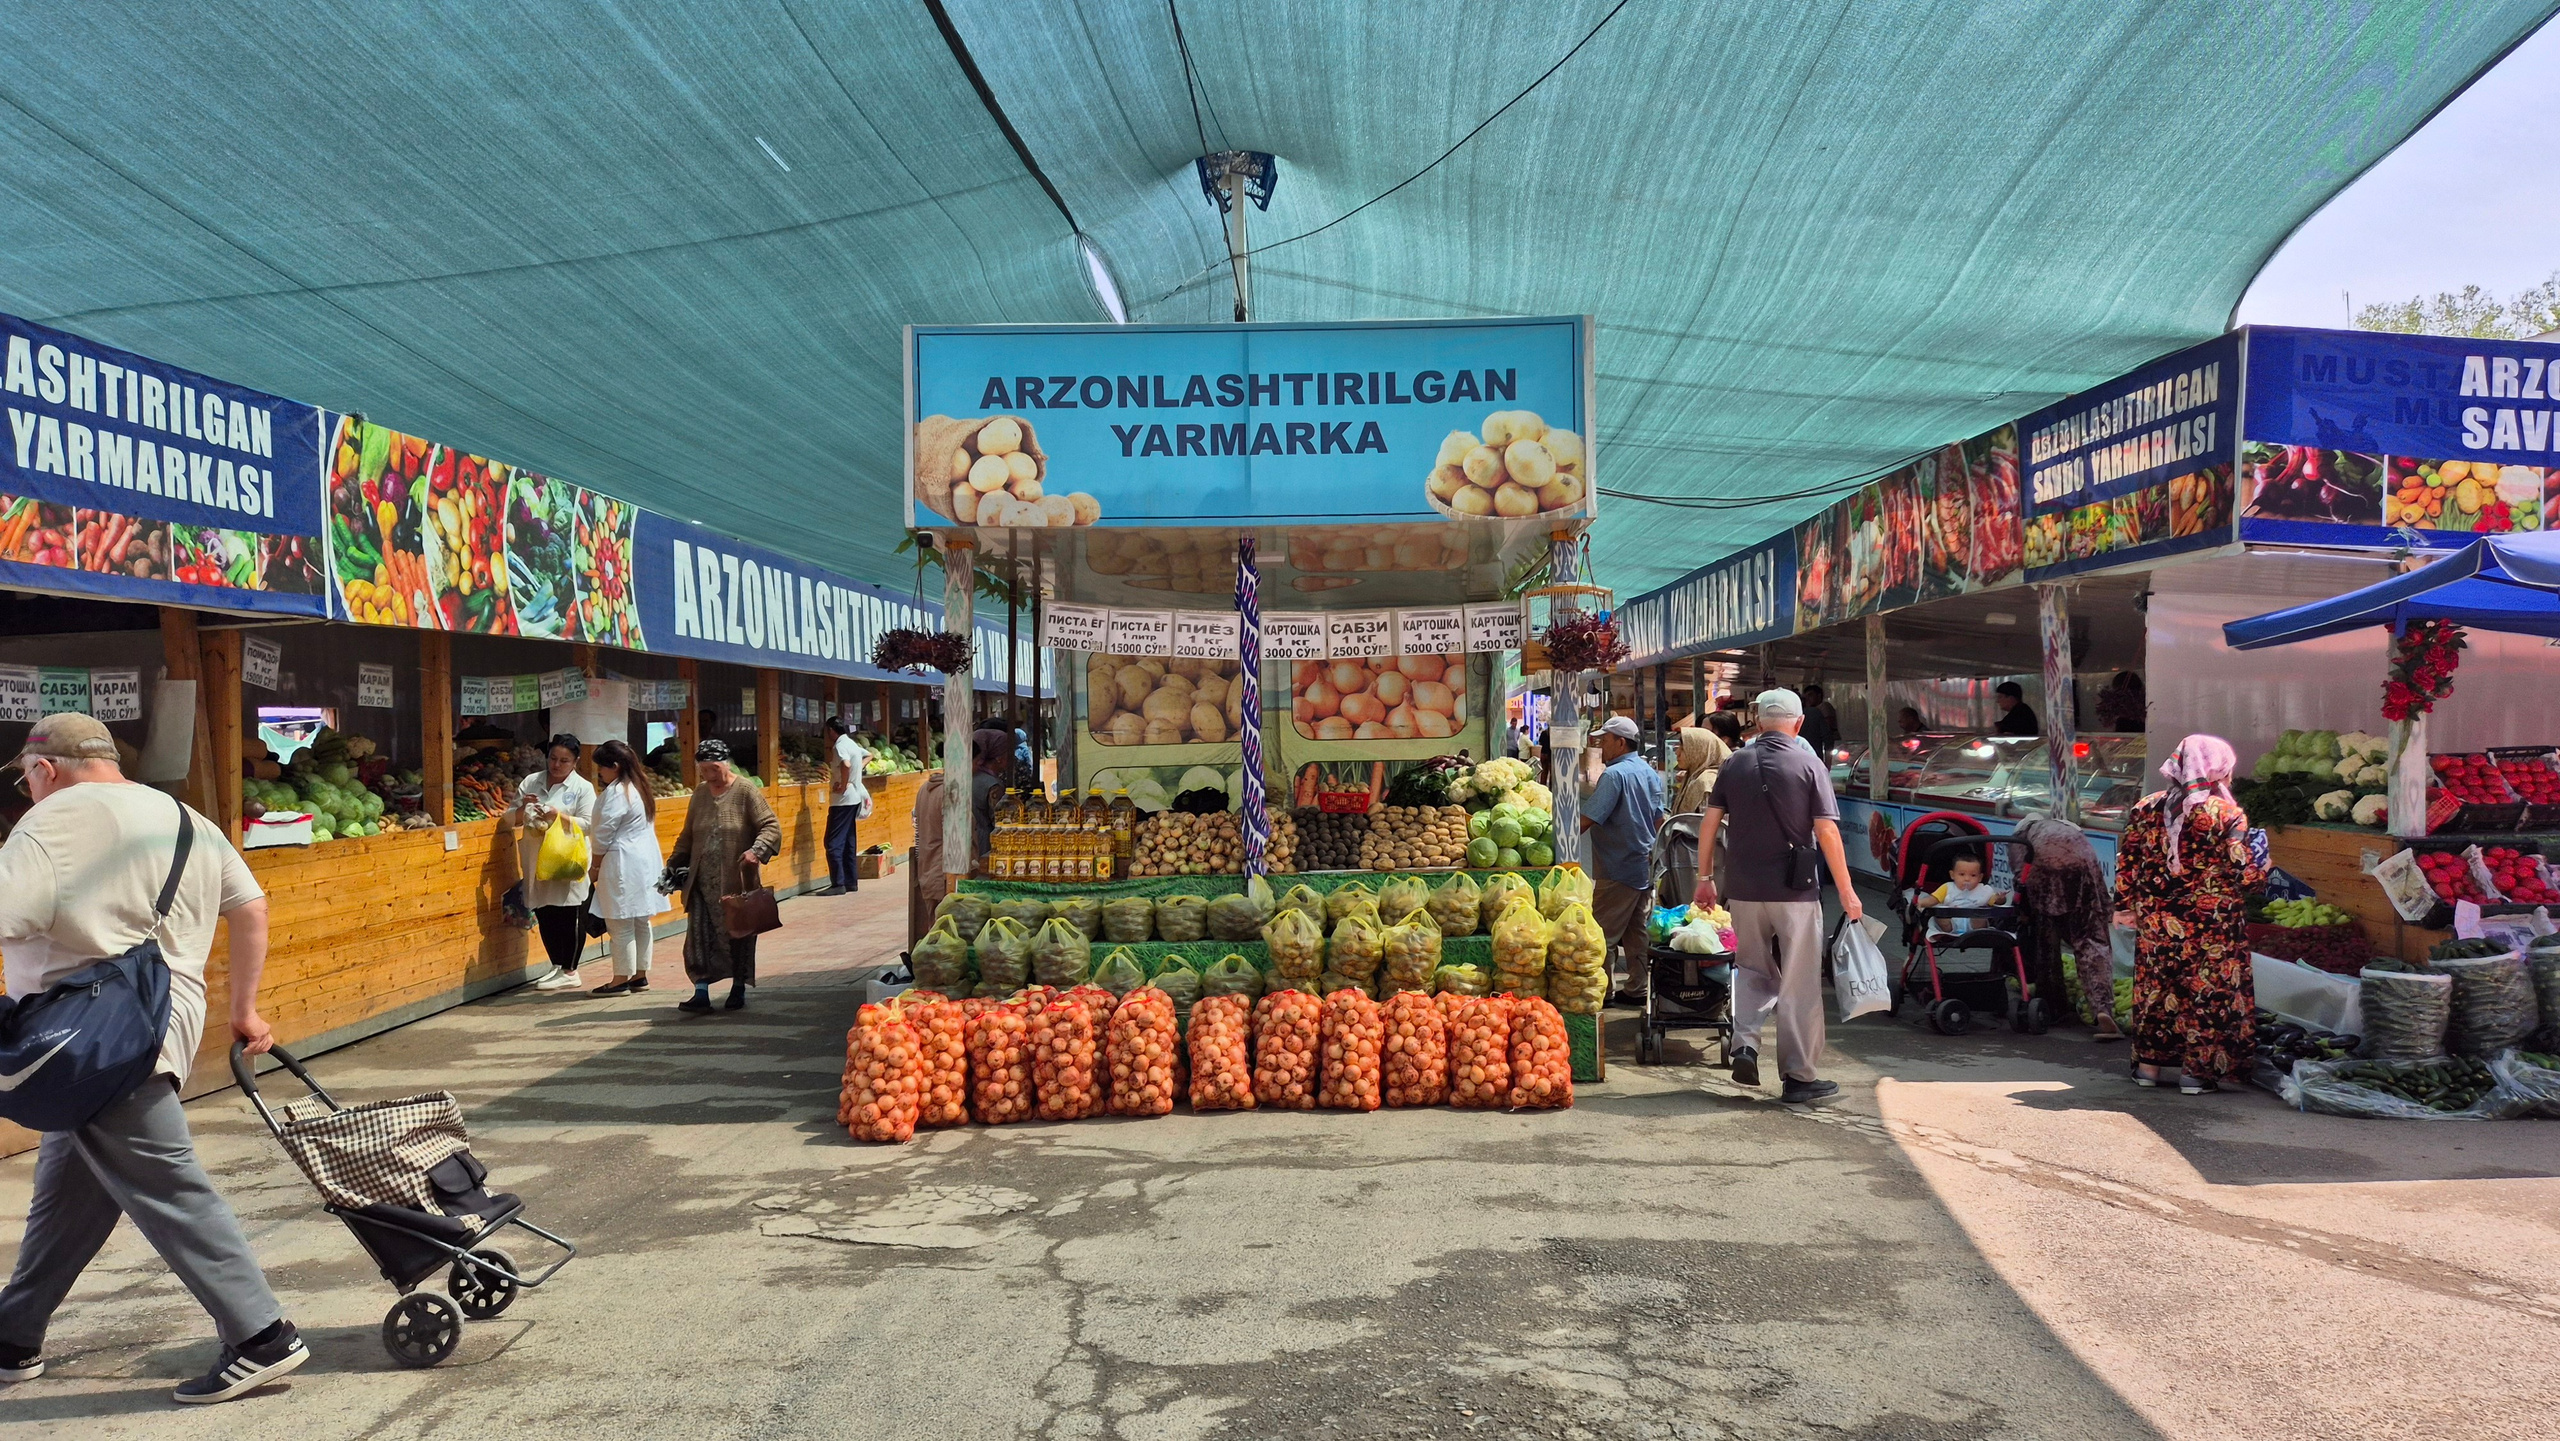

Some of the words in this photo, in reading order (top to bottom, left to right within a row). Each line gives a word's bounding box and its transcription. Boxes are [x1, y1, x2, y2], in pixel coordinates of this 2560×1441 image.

[978, 369, 1518, 410] ARZONLASHTIRILGAN
[0, 334, 273, 458] ASHTIRILGAN
[1110, 421, 1388, 458] YARMARKA
[2091, 412, 2216, 486] YARMARKASI
[8, 407, 274, 519] YARMARKASI
[1671, 548, 1774, 650] YARMARKASI
[1048, 614, 1087, 627] ПИСТА
[1091, 617, 1105, 629] ЁГ
[1111, 621, 1150, 632] ПИСТА
[1154, 620, 1168, 632] ЁГ
[1403, 618, 1460, 632] КАРТОШКА
[1471, 614, 1521, 629] КАРТОШК
[1058, 626, 1065, 634] 5
[1068, 628, 1094, 637] литр
[1177, 622, 1235, 636] ПИЁЗ
[1264, 624, 1321, 636] КАРТОШКА
[1330, 621, 1388, 635] САБЗИ
[1482, 629, 1490, 637] 1
[1499, 629, 1518, 637] кг
[1131, 634, 1157, 642] литр
[1188, 635, 1196, 644] 1
[1204, 637, 1223, 646] кг
[1275, 638, 1283, 646] 1
[1342, 635, 1349, 644] 1
[1356, 634, 1377, 643] кг
[1414, 632, 1422, 641] 1
[1047, 636, 1078, 649] 75000
[1081, 637, 1102, 651] СЎ
[1111, 643, 1142, 654] 15000
[1404, 643, 1432, 654] 5000
[1472, 639, 1500, 651] 4500
[1177, 645, 1205, 656] 2000
[1265, 648, 1292, 658] 3000
[1332, 645, 1360, 657] 2500
[253, 661, 259, 670] 1
[261, 666, 272, 674] кг
[245, 671, 263, 685] 15000
[264, 676, 276, 687] СЎ
[360, 673, 390, 687] КАРАМ
[40, 682, 87, 696] САБЗИ
[94, 682, 137, 696] КАРАМ
[366, 686, 371, 694] 1
[490, 686, 513, 696] САБЗИ
[11, 696, 28, 705] кг
[48, 697, 55, 706] 1
[62, 699, 78, 707] кг
[103, 697, 110, 706] 1
[116, 698, 130, 706] кг
[360, 695, 375, 705] 1500
[15, 705, 37, 720] СЎ
[96, 708, 117, 720] 1500
